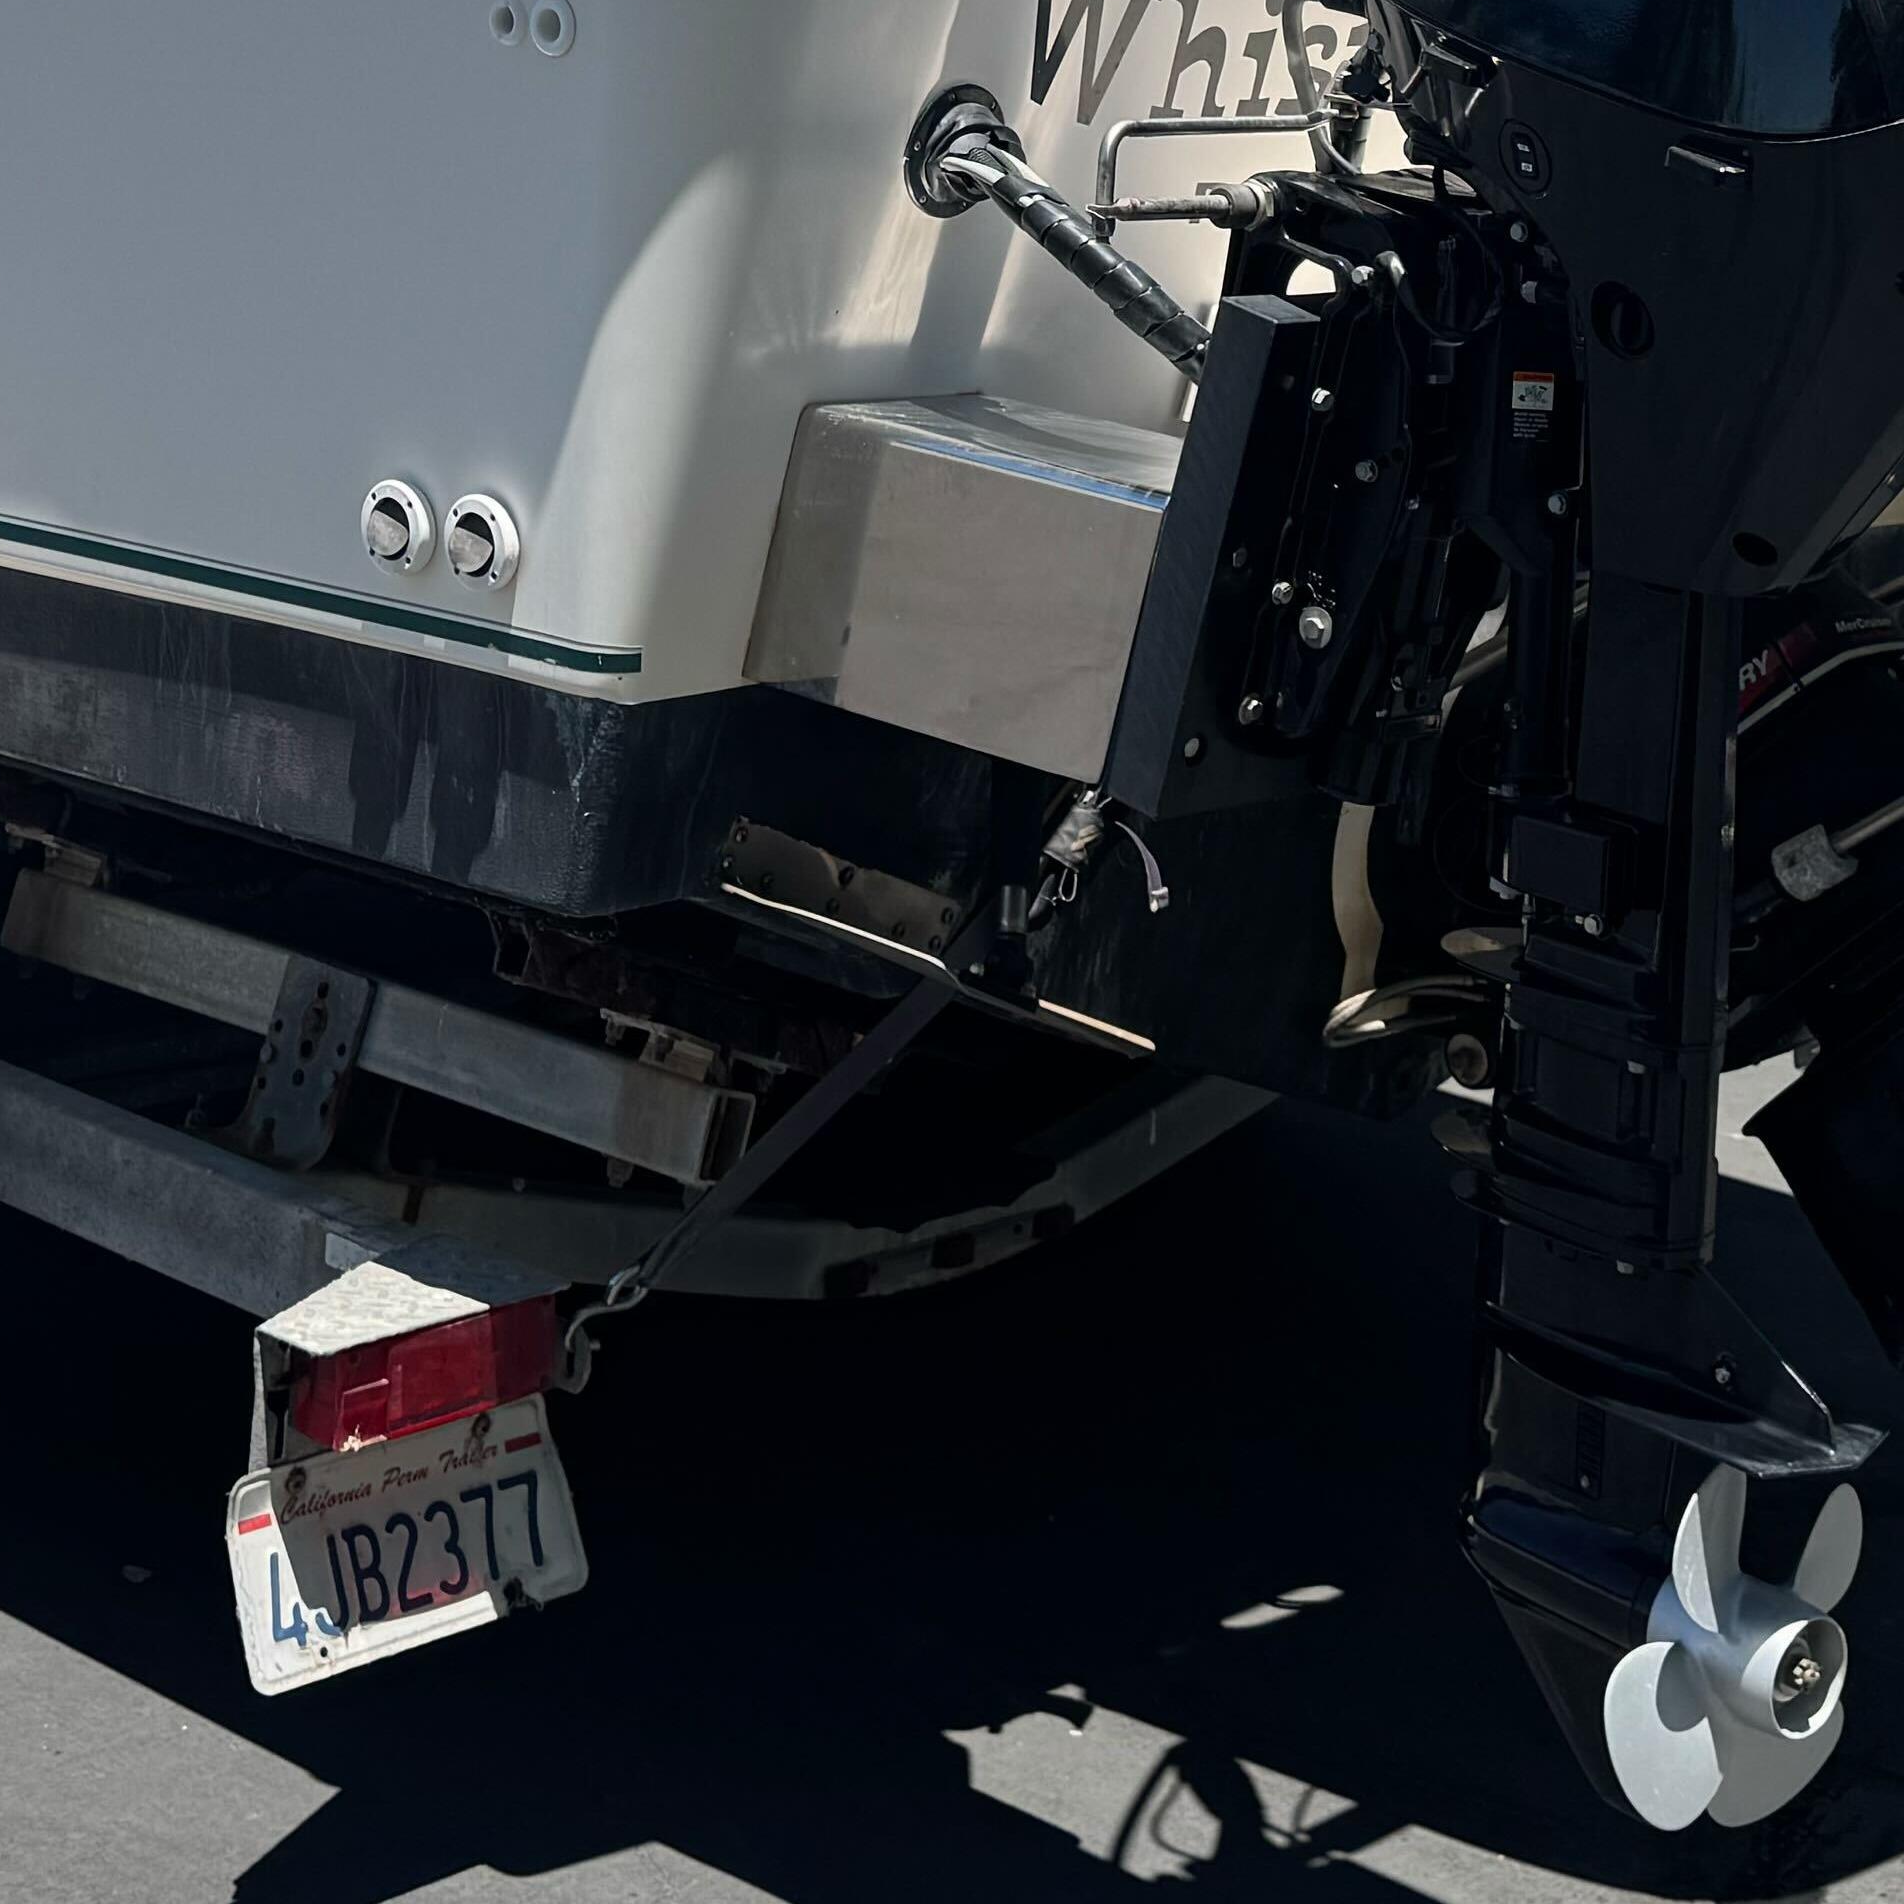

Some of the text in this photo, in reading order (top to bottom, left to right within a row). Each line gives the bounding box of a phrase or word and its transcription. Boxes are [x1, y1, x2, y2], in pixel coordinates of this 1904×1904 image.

[280, 1443, 499, 1526] California Perm Trailer
[268, 1469, 545, 1648] 4JB2377
